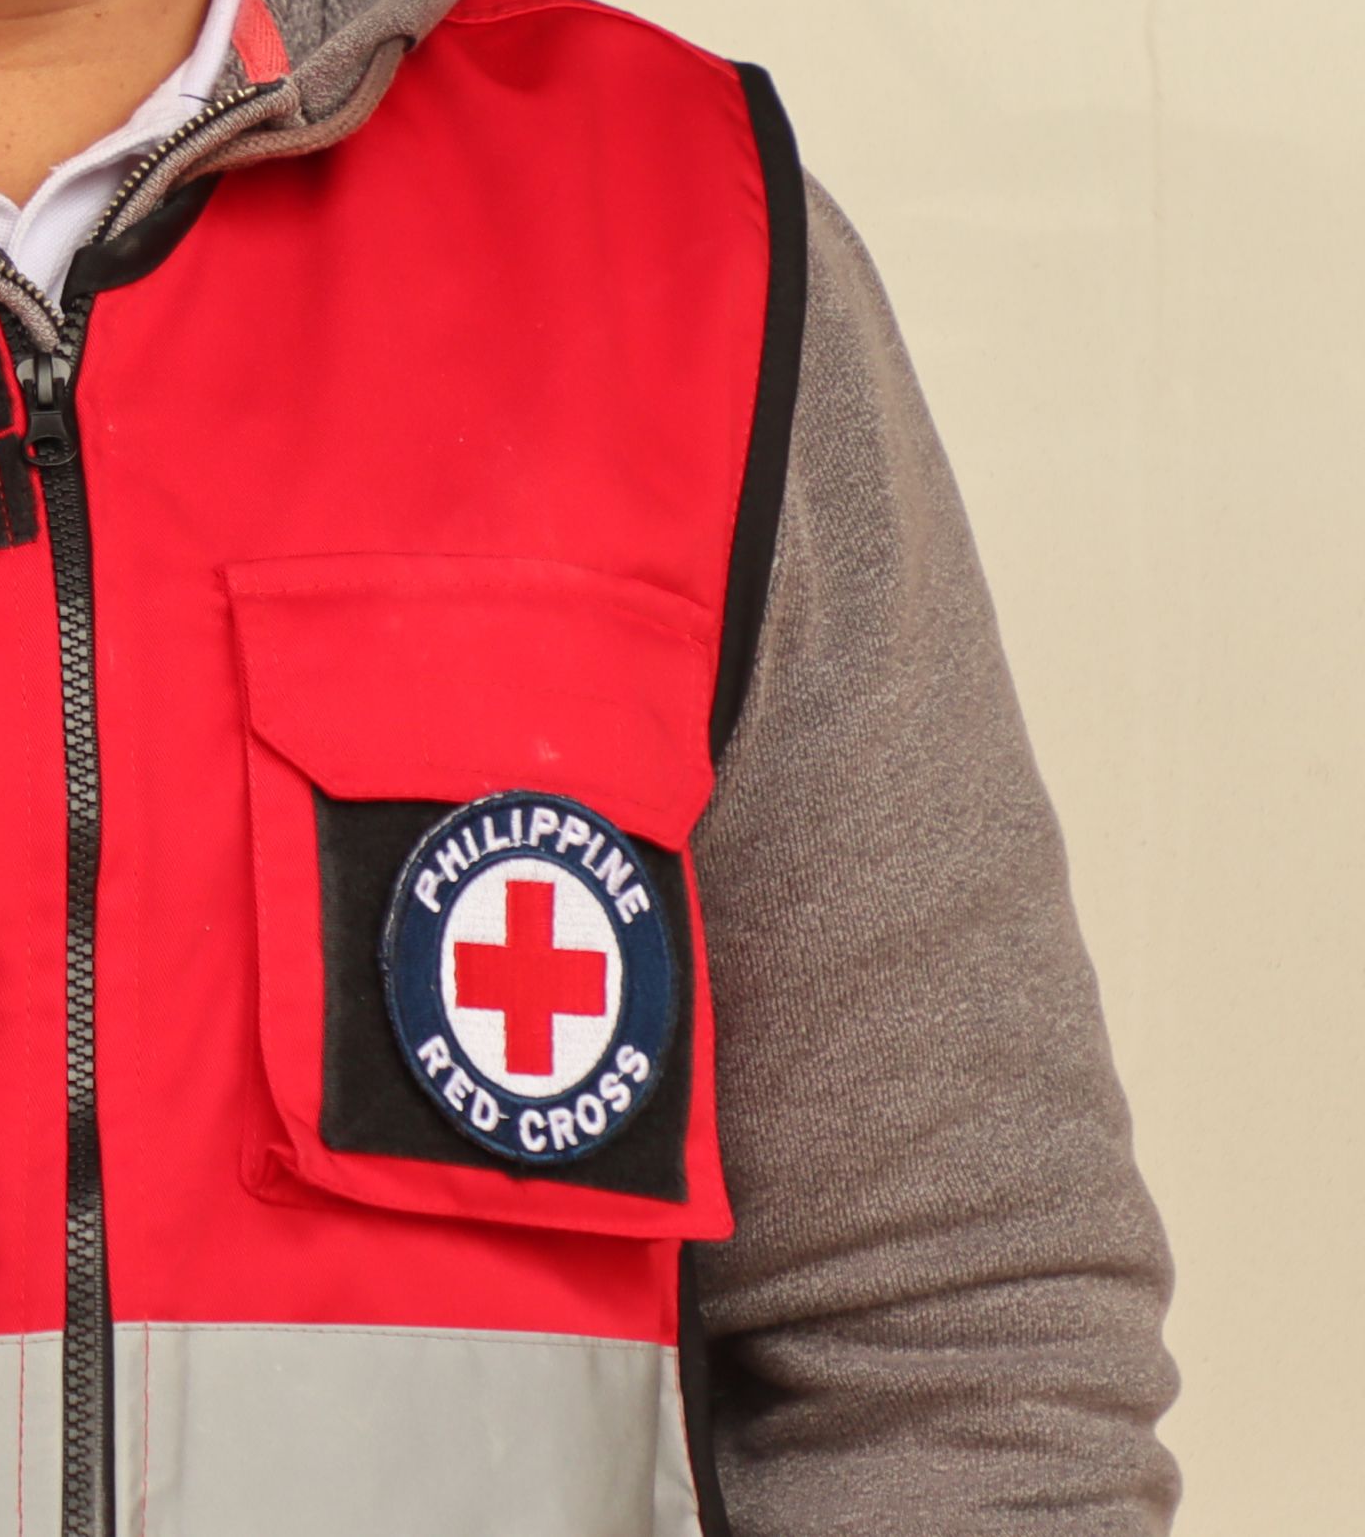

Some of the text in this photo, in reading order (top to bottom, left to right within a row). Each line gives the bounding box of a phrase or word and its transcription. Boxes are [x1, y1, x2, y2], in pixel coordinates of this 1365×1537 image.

[414, 806, 650, 925] PHILIPPINE
[417, 1034, 650, 1153] RED CROSS
